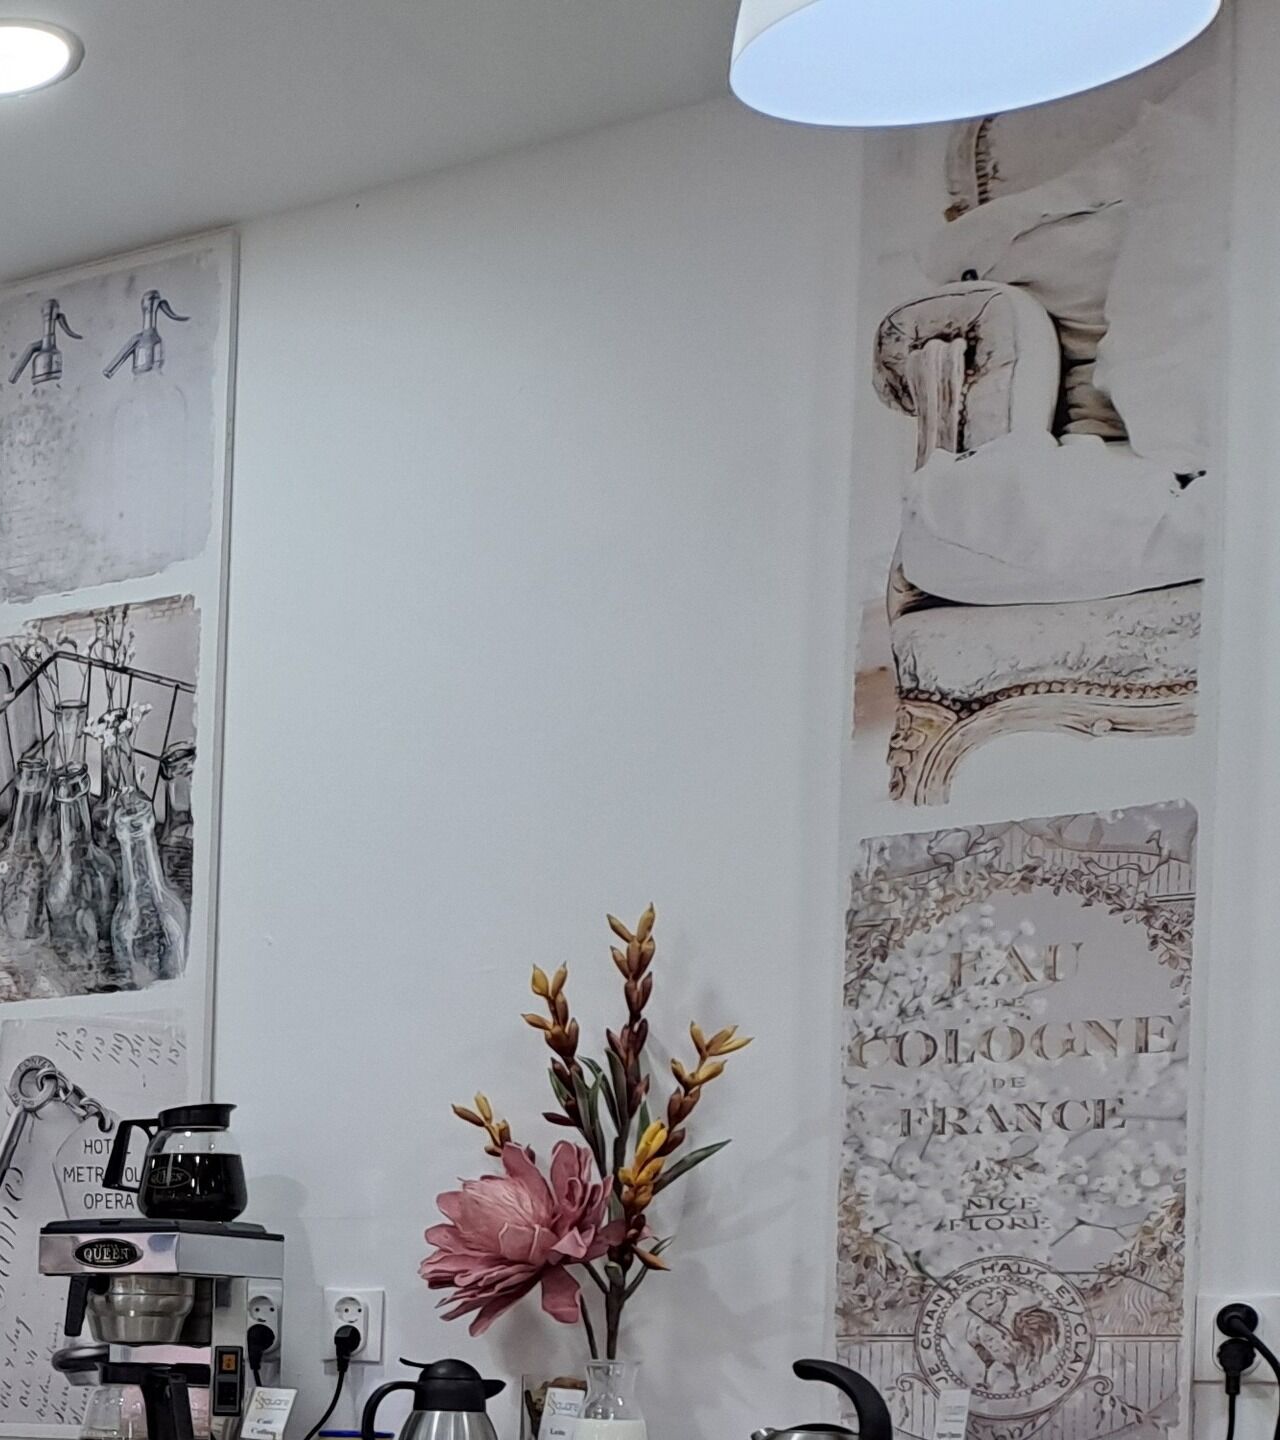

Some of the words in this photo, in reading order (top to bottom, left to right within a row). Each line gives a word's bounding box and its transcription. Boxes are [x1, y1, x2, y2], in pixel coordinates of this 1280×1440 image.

[949, 942, 1084, 988] EAU
[848, 1015, 1178, 1069] COLOGNE
[992, 1076, 1026, 1090] DE
[899, 1098, 1127, 1137] FRANCE
[83, 1138, 131, 1155] HOT
[63, 1166, 141, 1183] METROL
[83, 1192, 135, 1210] OPERA
[965, 1197, 1039, 1211] NICE
[83, 1247, 130, 1263] QUEEN
[1055, 1284, 1080, 1309] ET
[1056, 1322, 1088, 1389] CLAIR
